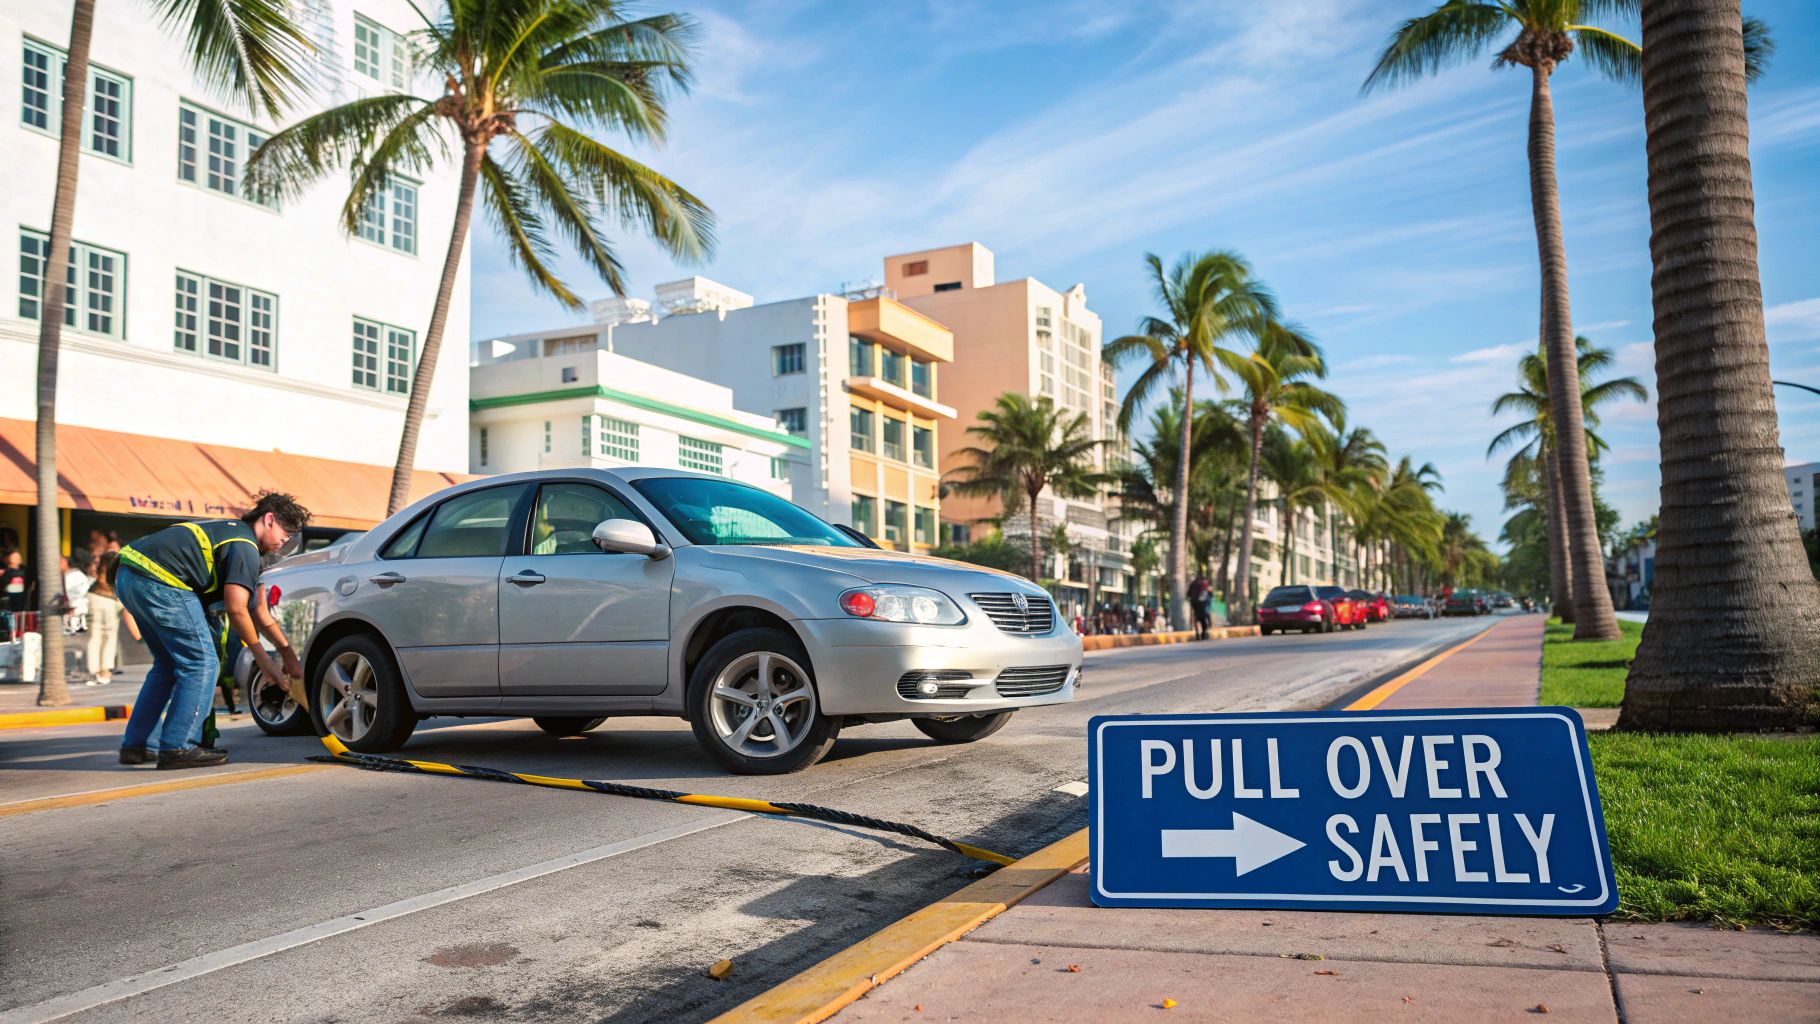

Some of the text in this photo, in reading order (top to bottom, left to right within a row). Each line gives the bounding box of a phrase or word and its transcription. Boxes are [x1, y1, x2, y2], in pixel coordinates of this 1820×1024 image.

[1140, 734, 1508, 800] PULL OVER
[1325, 813, 1556, 884] SAFELY
